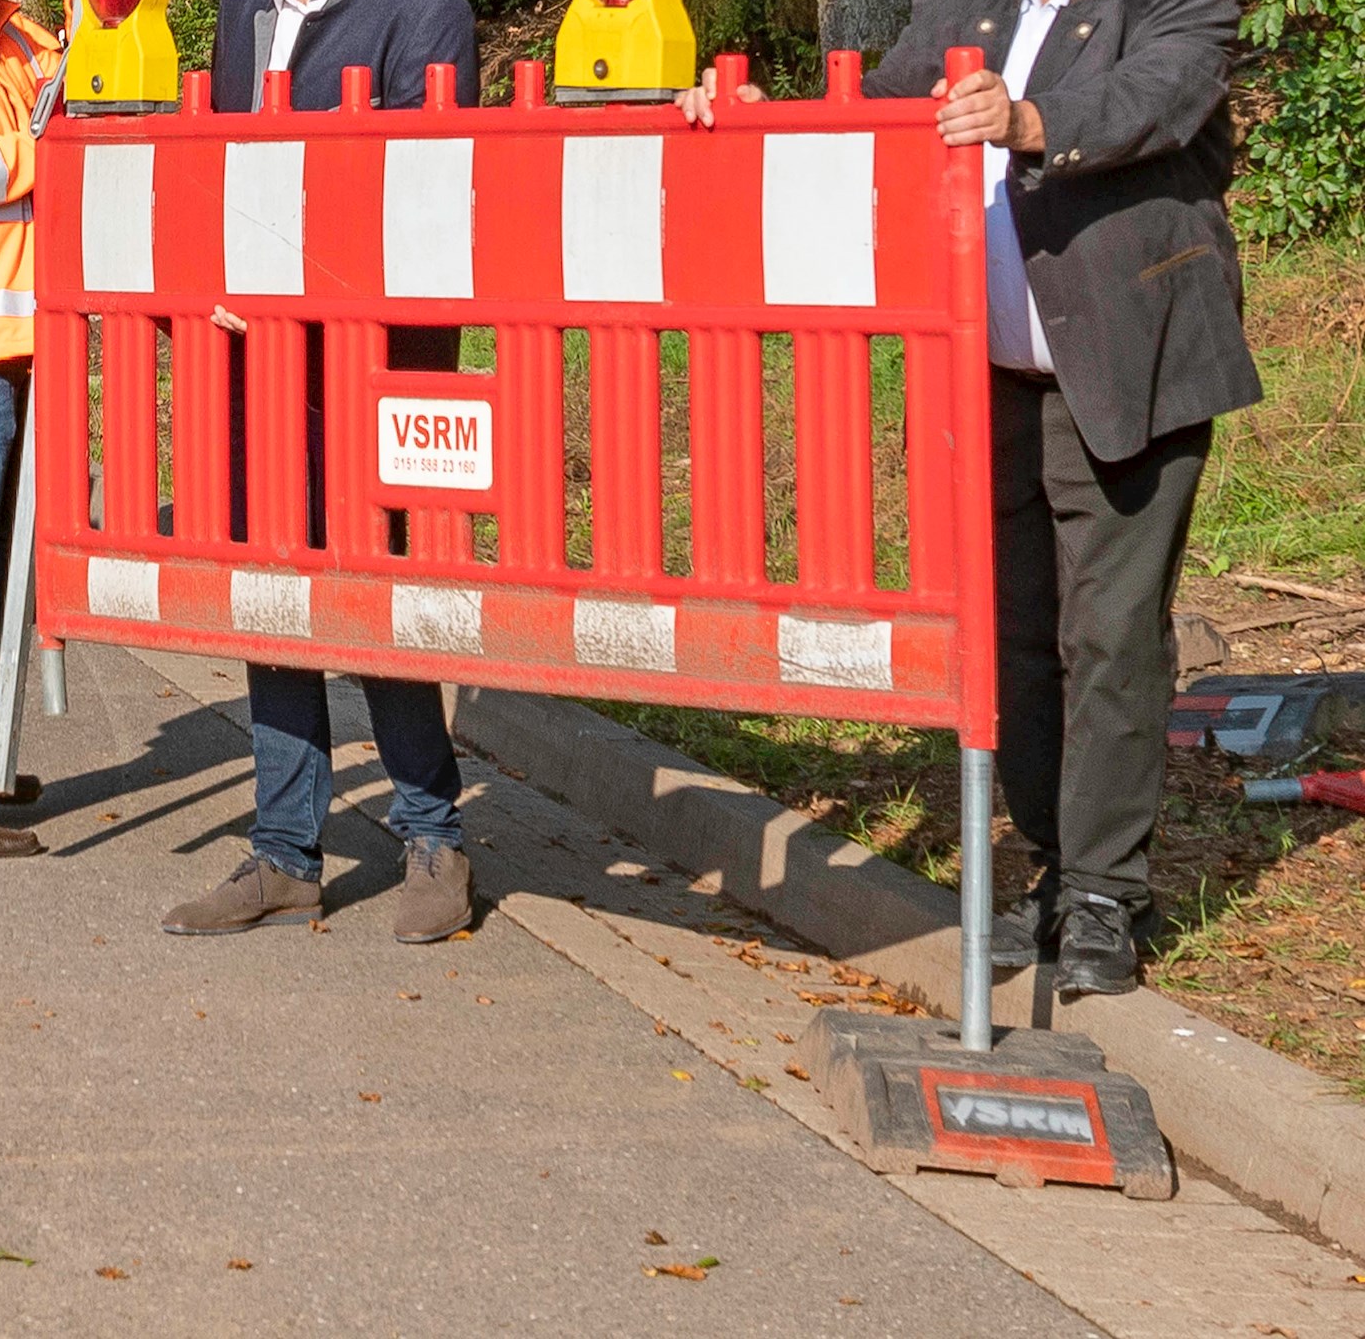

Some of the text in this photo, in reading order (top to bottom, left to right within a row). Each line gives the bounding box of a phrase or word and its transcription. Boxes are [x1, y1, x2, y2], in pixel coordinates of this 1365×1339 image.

[391, 413, 477, 452] VSRM
[393, 457, 417, 470] 0151
[442, 459, 455, 473] 23
[942, 1096, 1092, 1139] VSRM
